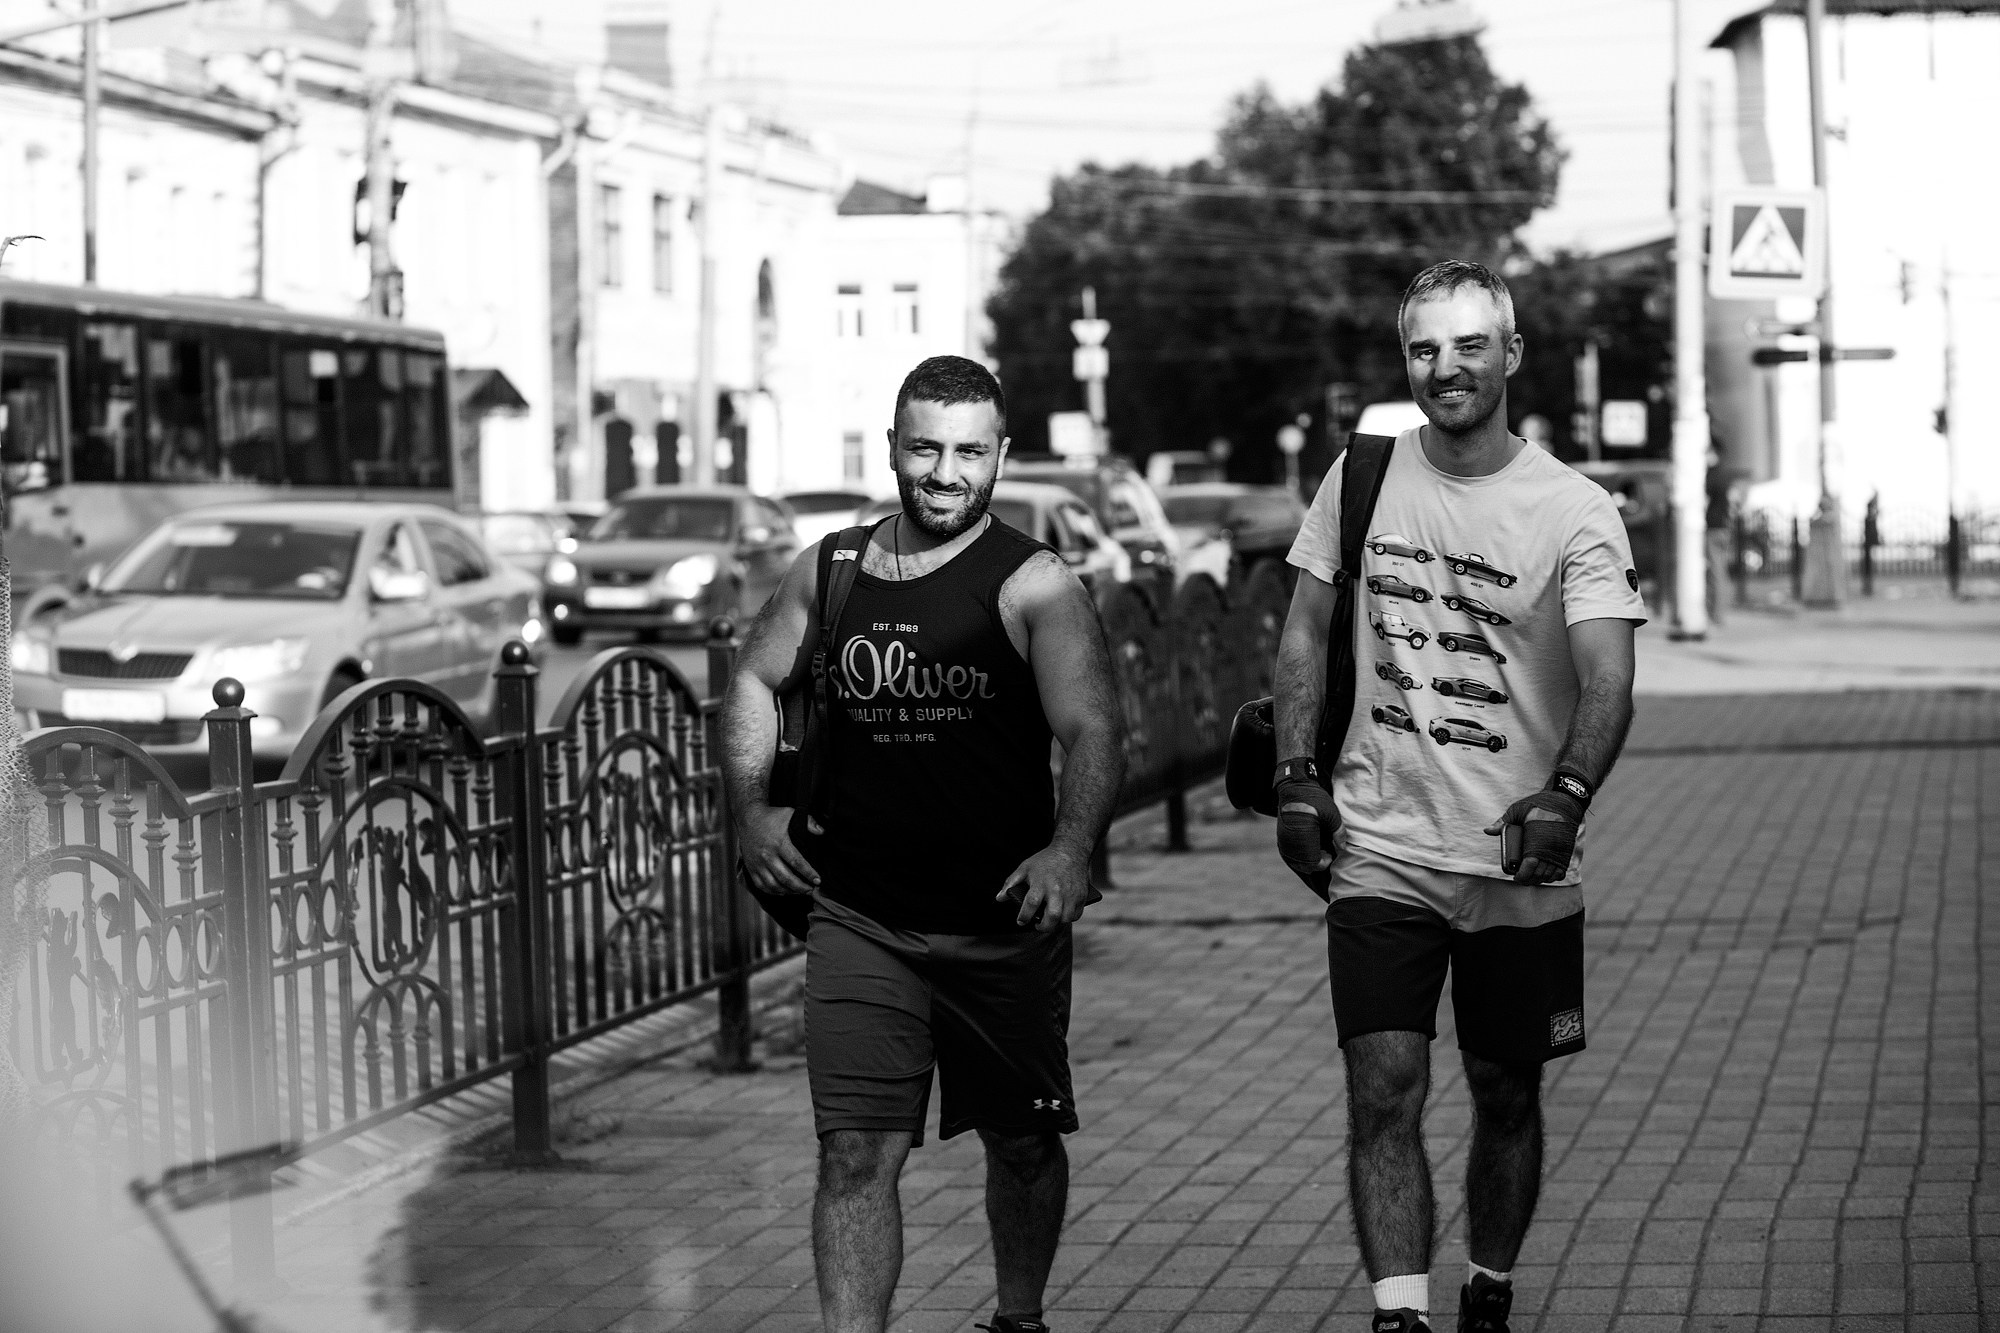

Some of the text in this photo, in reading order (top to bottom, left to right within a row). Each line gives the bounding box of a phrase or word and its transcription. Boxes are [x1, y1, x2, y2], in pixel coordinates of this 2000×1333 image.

[872, 622, 919, 633] EST. 1969
[847, 707, 974, 722] UALITY & SUPPLY
[873, 734, 892, 743] REG.
[915, 733, 937, 742] MFG.
